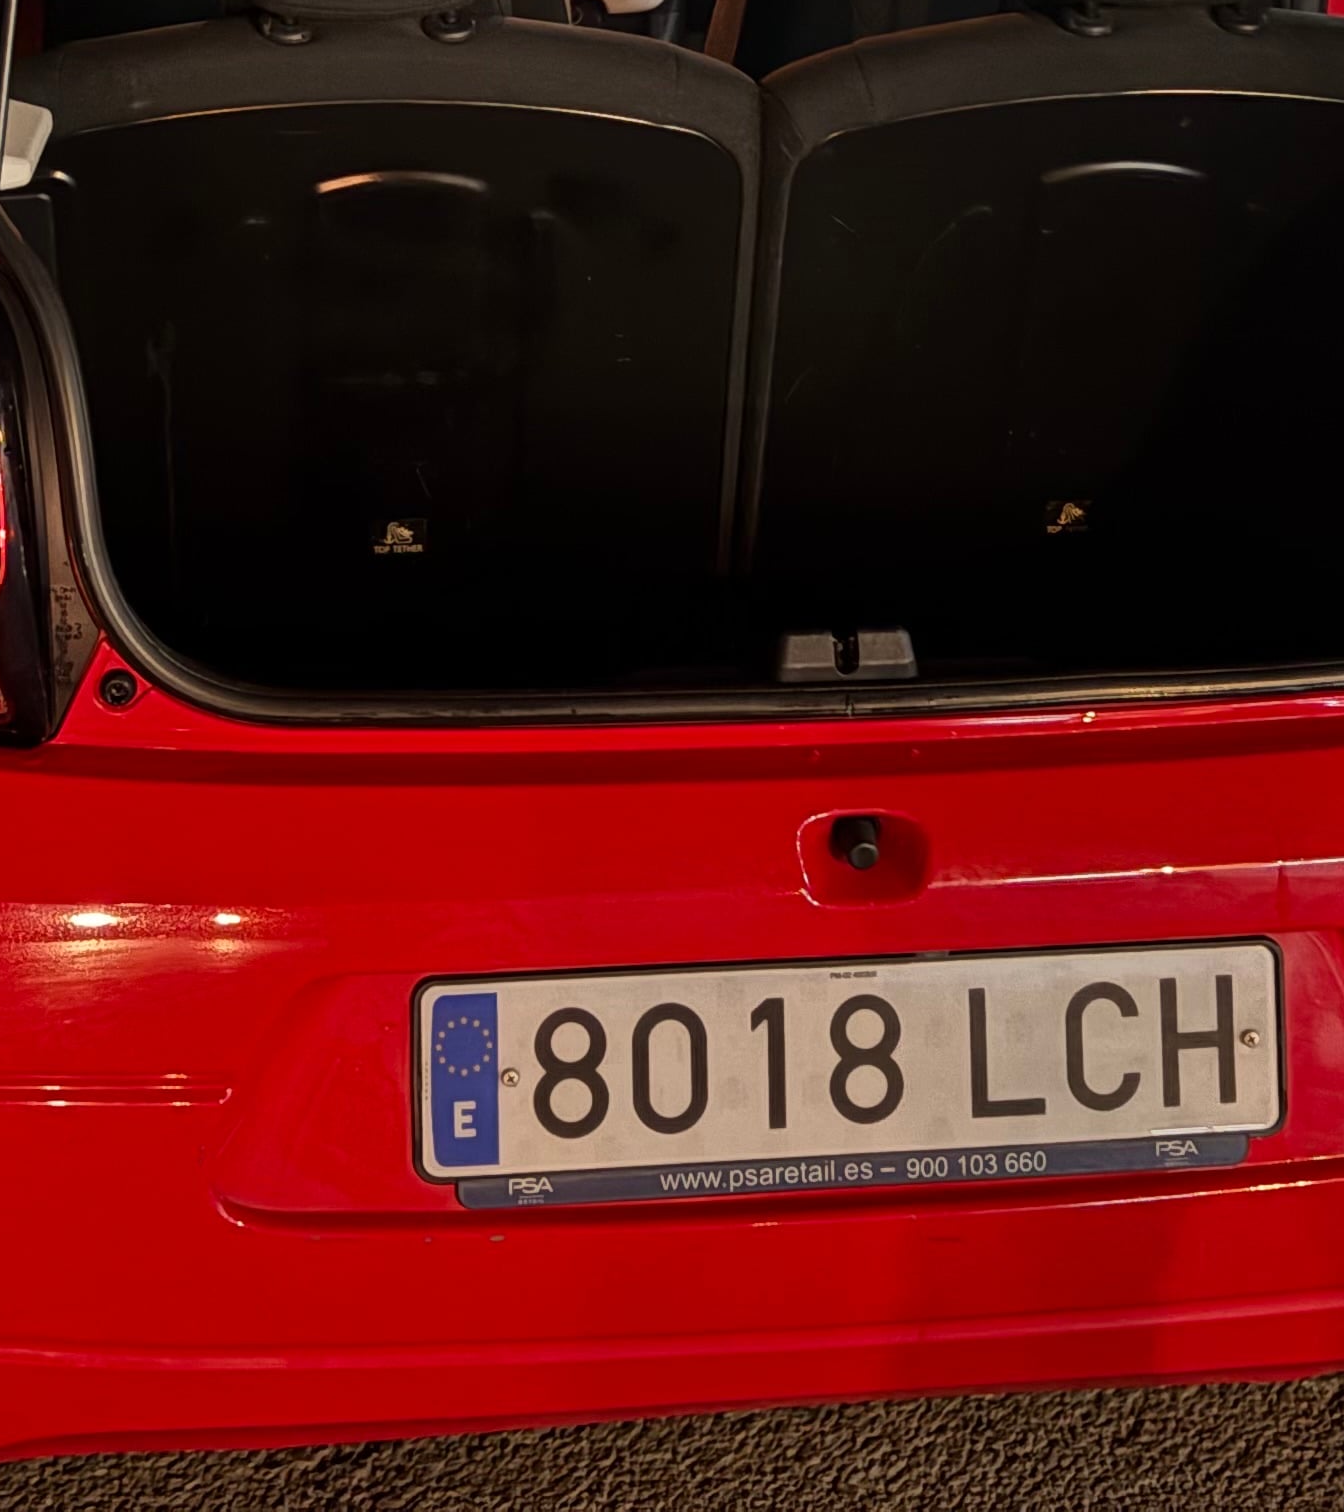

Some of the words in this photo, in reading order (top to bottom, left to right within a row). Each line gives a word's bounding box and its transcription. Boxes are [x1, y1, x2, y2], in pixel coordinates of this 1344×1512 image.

[533, 993, 905, 1139] 8018
[968, 974, 1237, 1118] LCH
[453, 1100, 477, 1139] E
[1155, 1140, 1200, 1157] PSA
[508, 1176, 554, 1196] PSA
[659, 1159, 874, 1192] www.psaretail.es
[906, 1155, 949, 1180] 900
[958, 1153, 998, 1177] 103
[1004, 1150, 1048, 1174] 660
